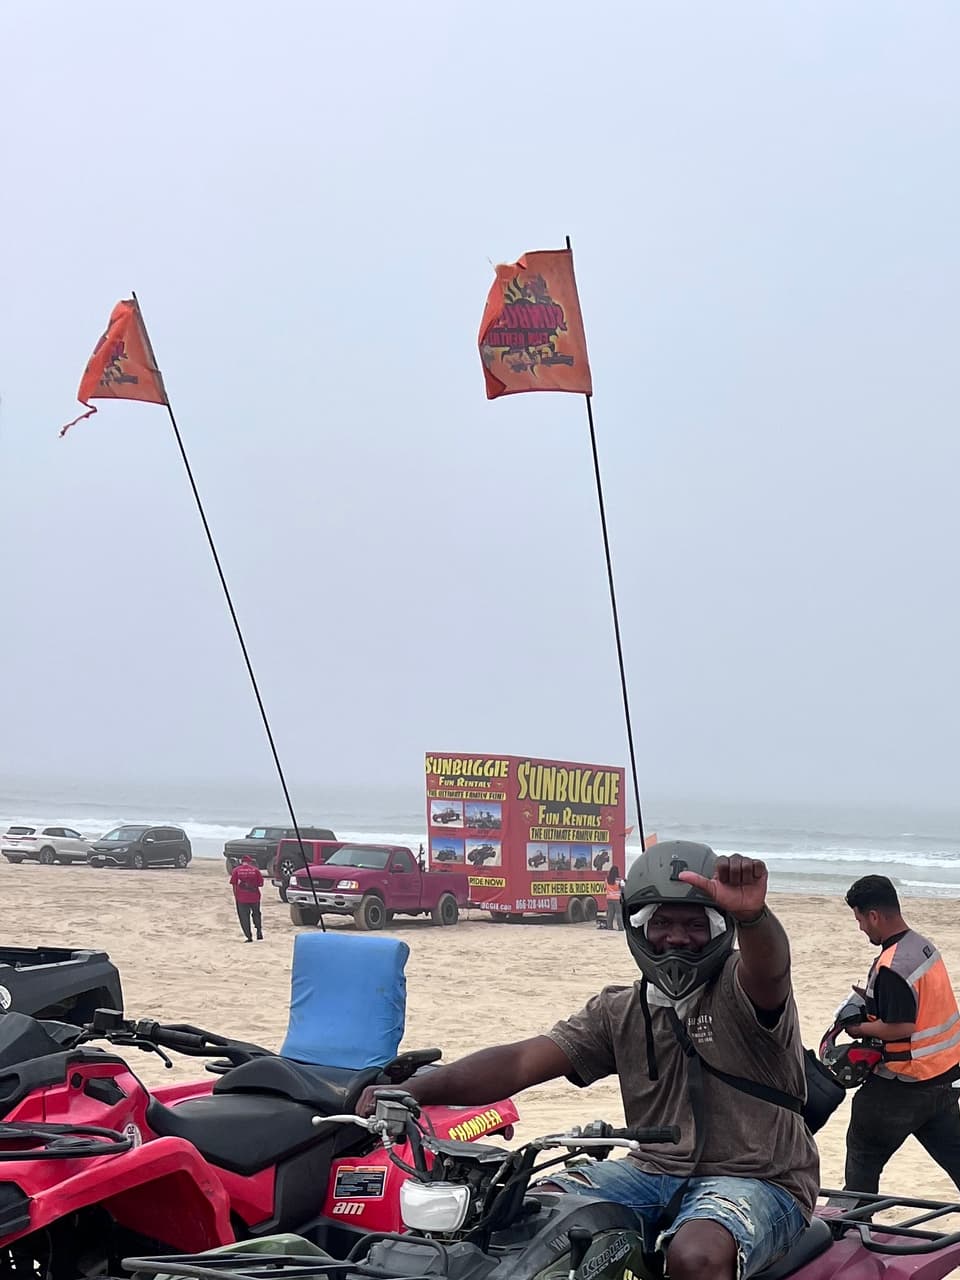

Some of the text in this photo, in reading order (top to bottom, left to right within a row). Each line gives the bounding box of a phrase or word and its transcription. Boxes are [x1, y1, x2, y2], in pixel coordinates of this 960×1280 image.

[425, 756, 509, 777] SUNBUGGIE
[517, 761, 620, 805] SUNBUGGIE
[538, 805, 602, 827] FUN RENTALS
[531, 828, 543, 840] THE
[543, 829, 571, 840] ULTIMATE
[572, 830, 593, 841] FAMILY
[469, 877, 504, 887] RIDE NOW
[532, 883, 549, 894] RENT
[551, 883, 568, 894] HERE
[569, 883, 575, 893] &
[575, 883, 590, 894] RIDE
[448, 1109, 503, 1142] CHANDLER
[332, 1201, 365, 1215] am
